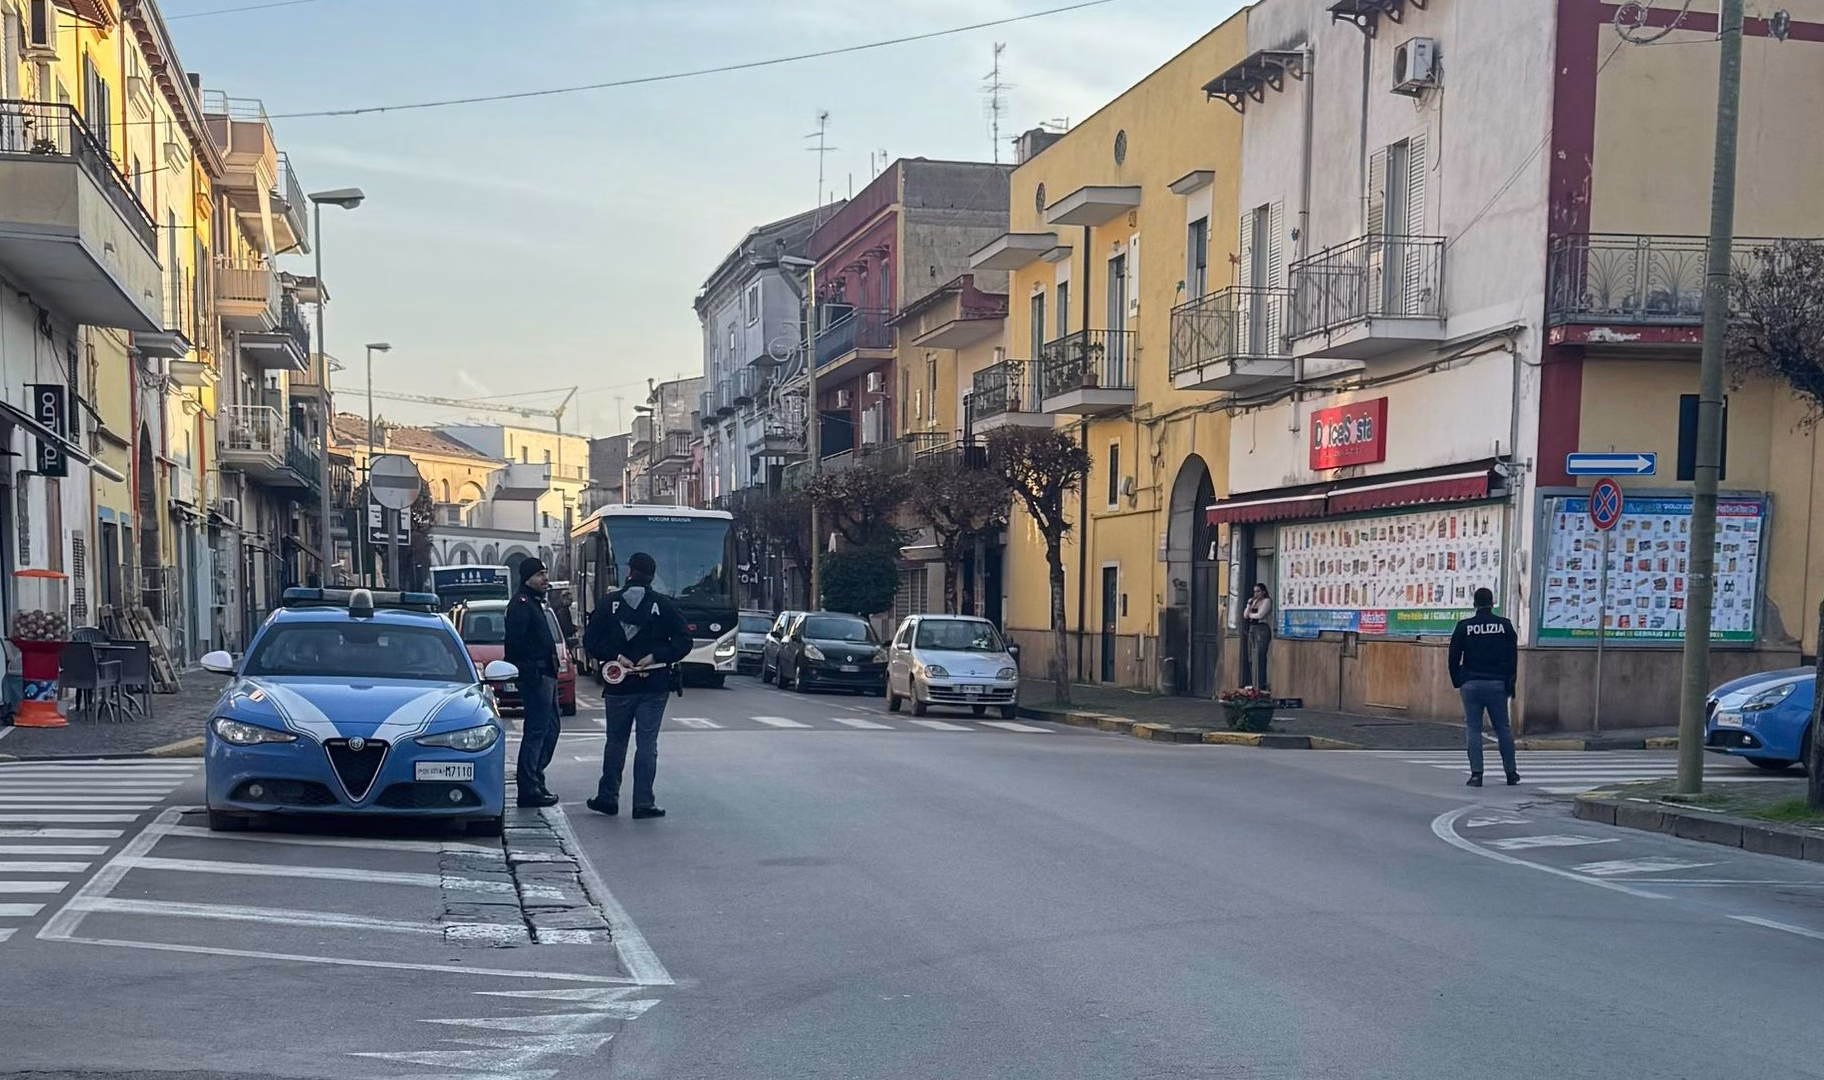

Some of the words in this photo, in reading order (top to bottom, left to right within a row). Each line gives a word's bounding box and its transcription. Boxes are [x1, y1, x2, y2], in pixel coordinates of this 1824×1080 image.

[42, 392, 57, 469] TOALDO
[1466, 623, 1505, 635] POLIZIA
[445, 765, 472, 778] M7110
